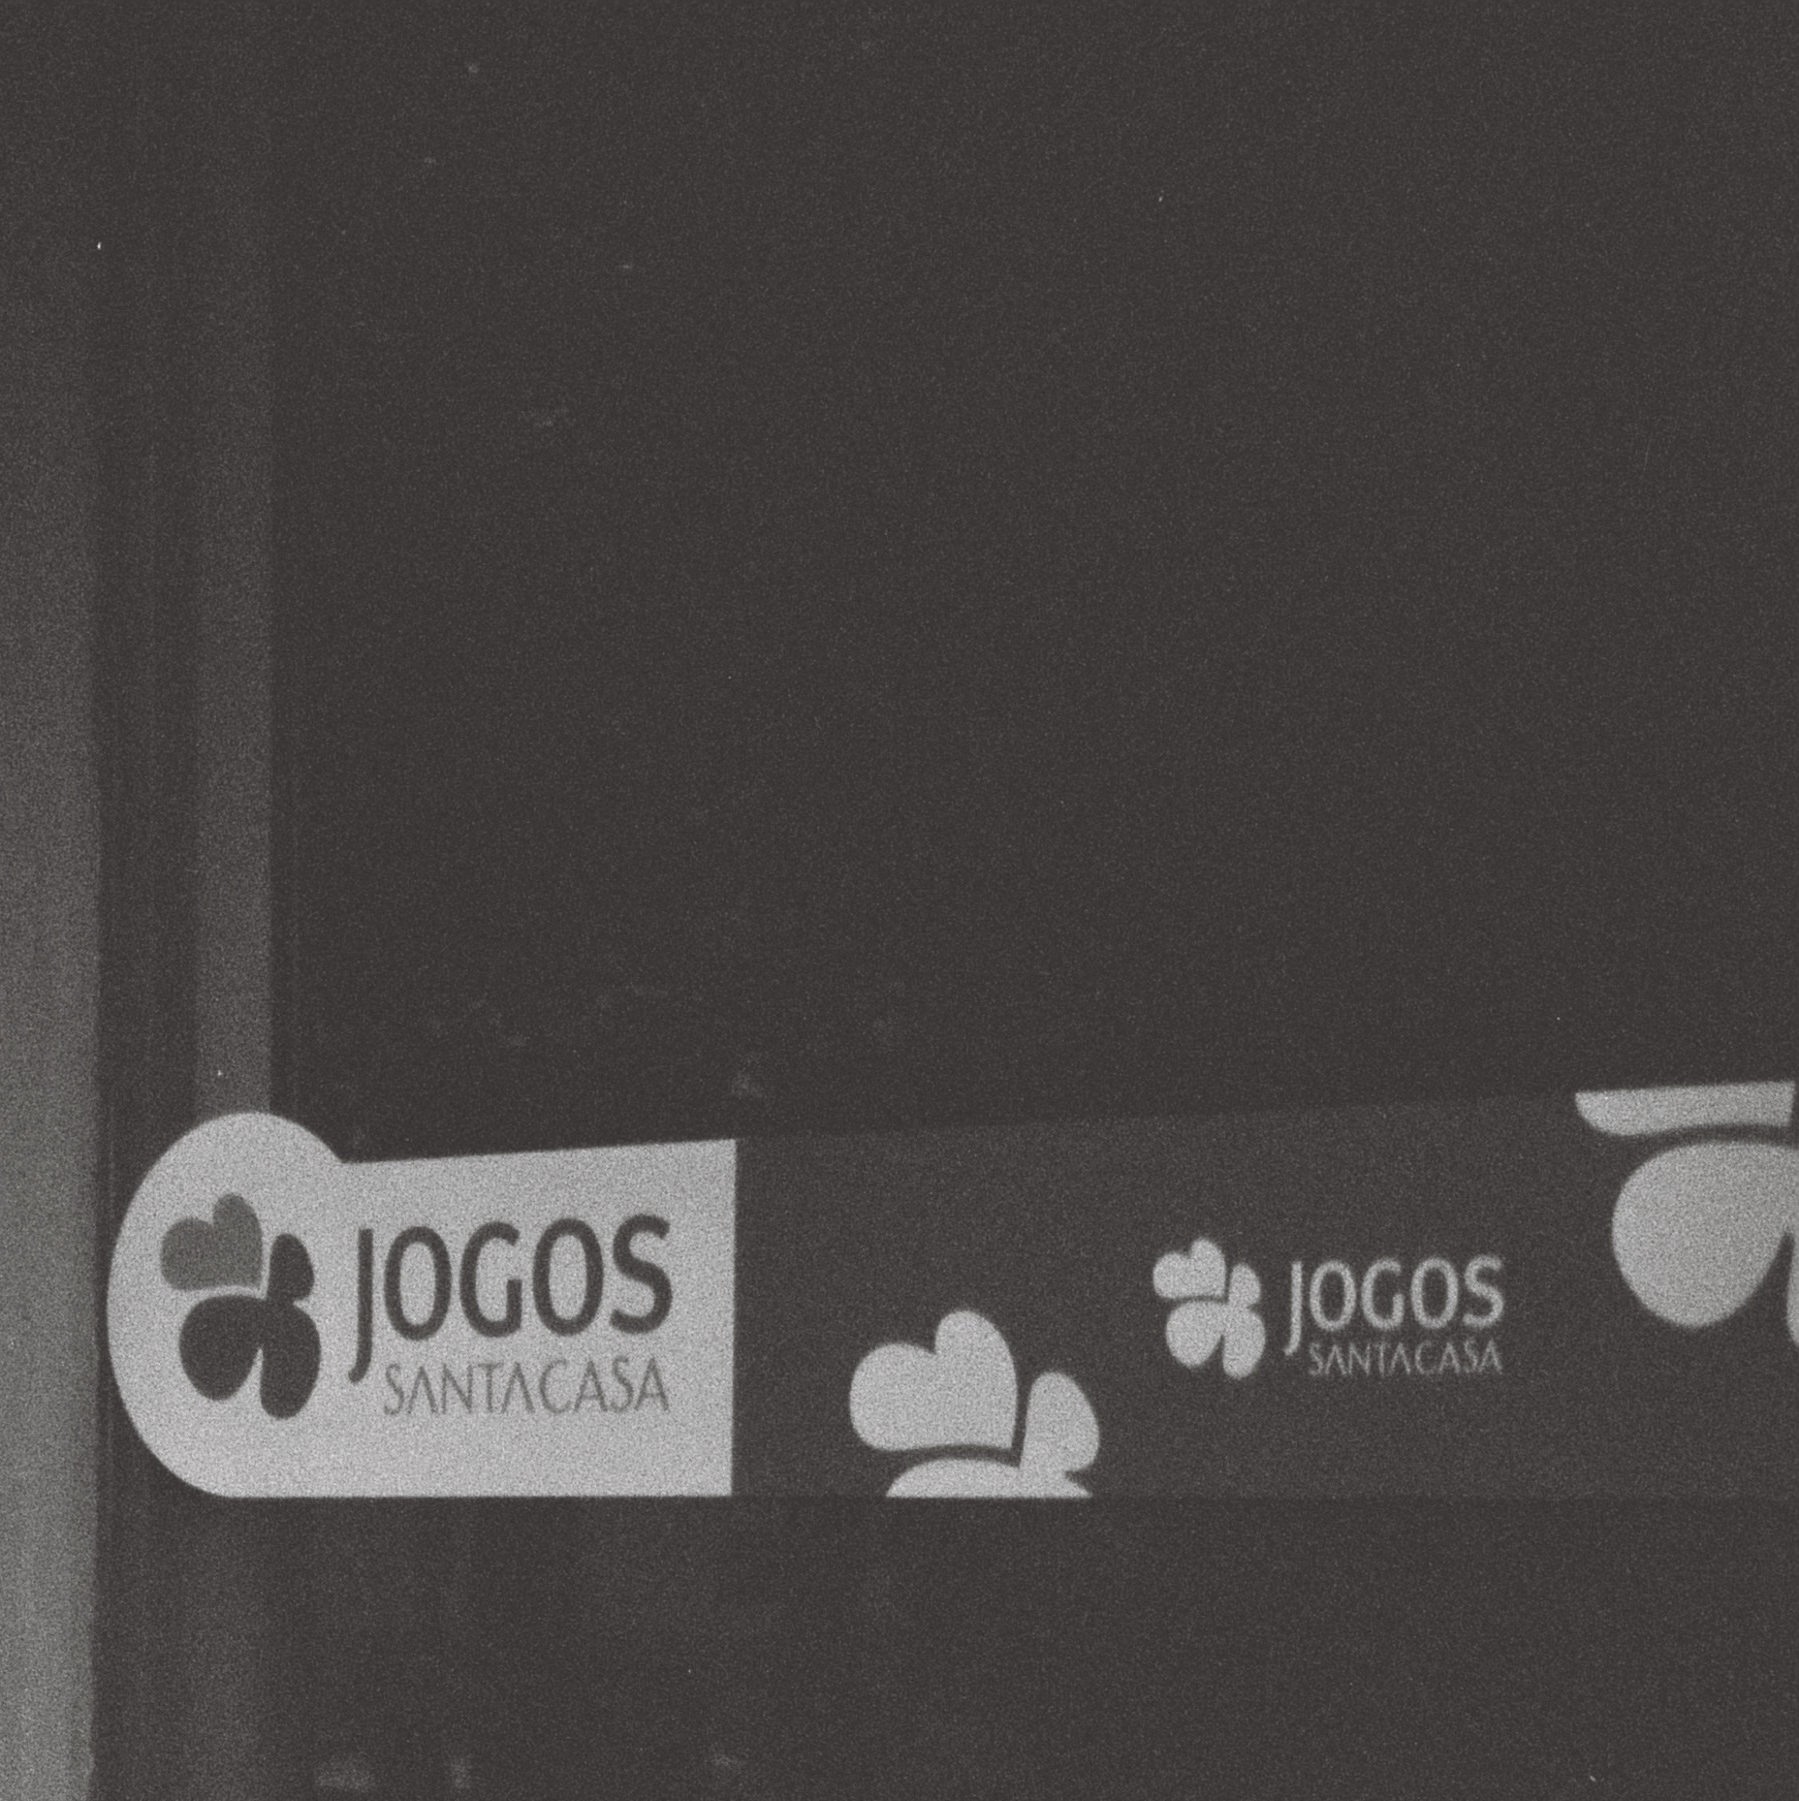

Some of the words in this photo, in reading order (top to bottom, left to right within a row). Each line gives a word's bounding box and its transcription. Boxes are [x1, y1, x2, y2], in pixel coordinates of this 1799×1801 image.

[348, 1213, 673, 1385] JOGOS
[1284, 1254, 1504, 1357] JOGOS
[383, 1355, 670, 1416] SANTACASA
[1308, 1337, 1503, 1377] SANTACASA
